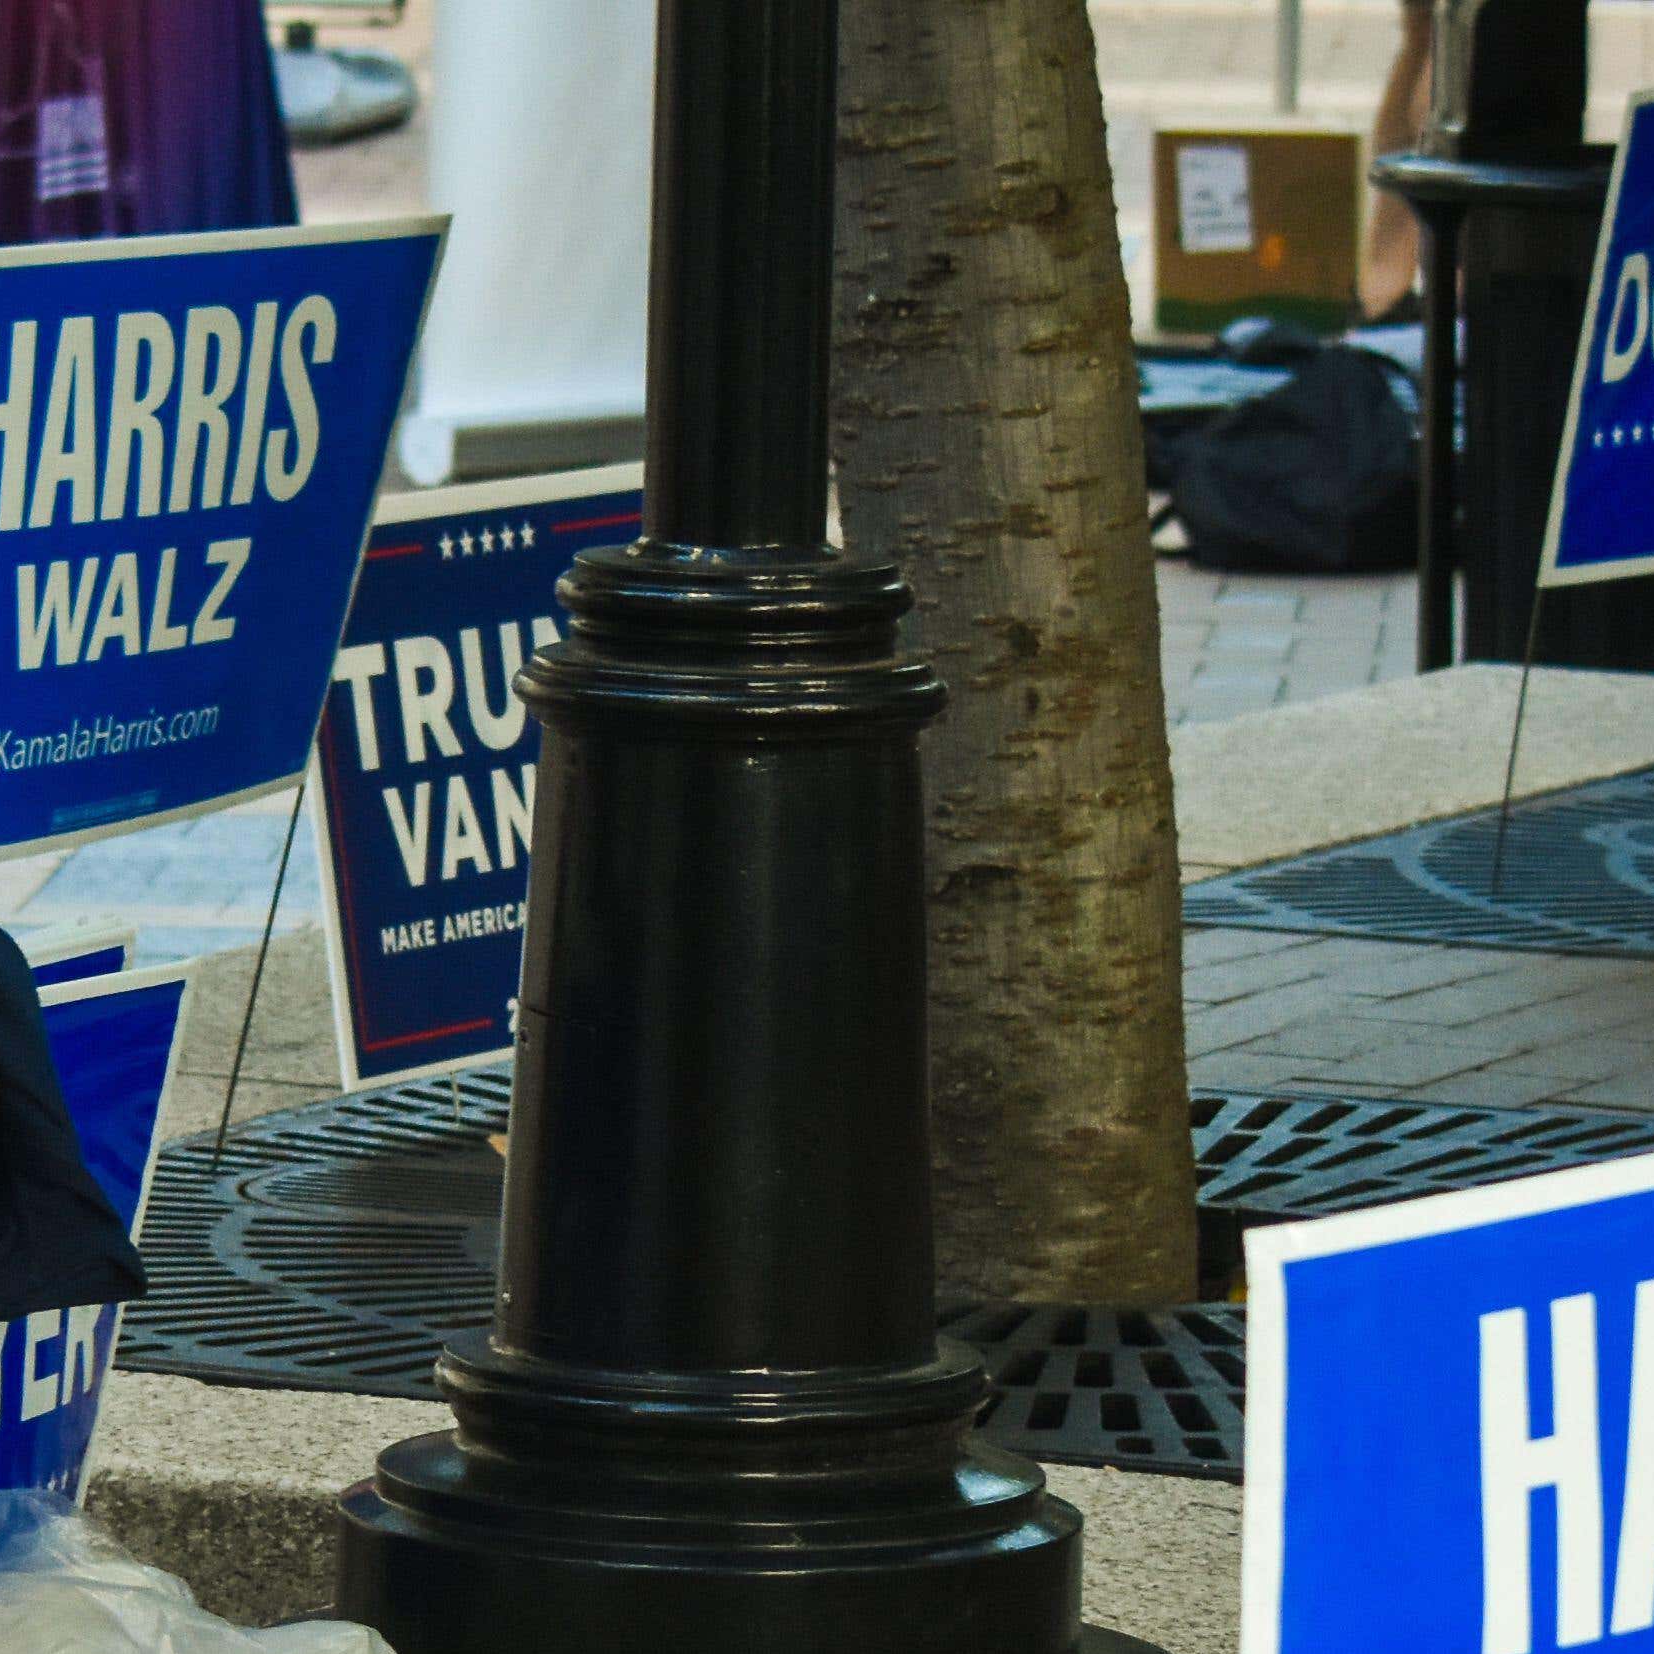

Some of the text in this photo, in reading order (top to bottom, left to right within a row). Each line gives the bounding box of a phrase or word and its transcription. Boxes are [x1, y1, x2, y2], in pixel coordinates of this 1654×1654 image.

[16, 537, 252, 672] WALZ
[333, 615, 563, 772] TRU
[382, 762, 538, 888] VAN
[380, 900, 529, 956] MAKE AMERICA
